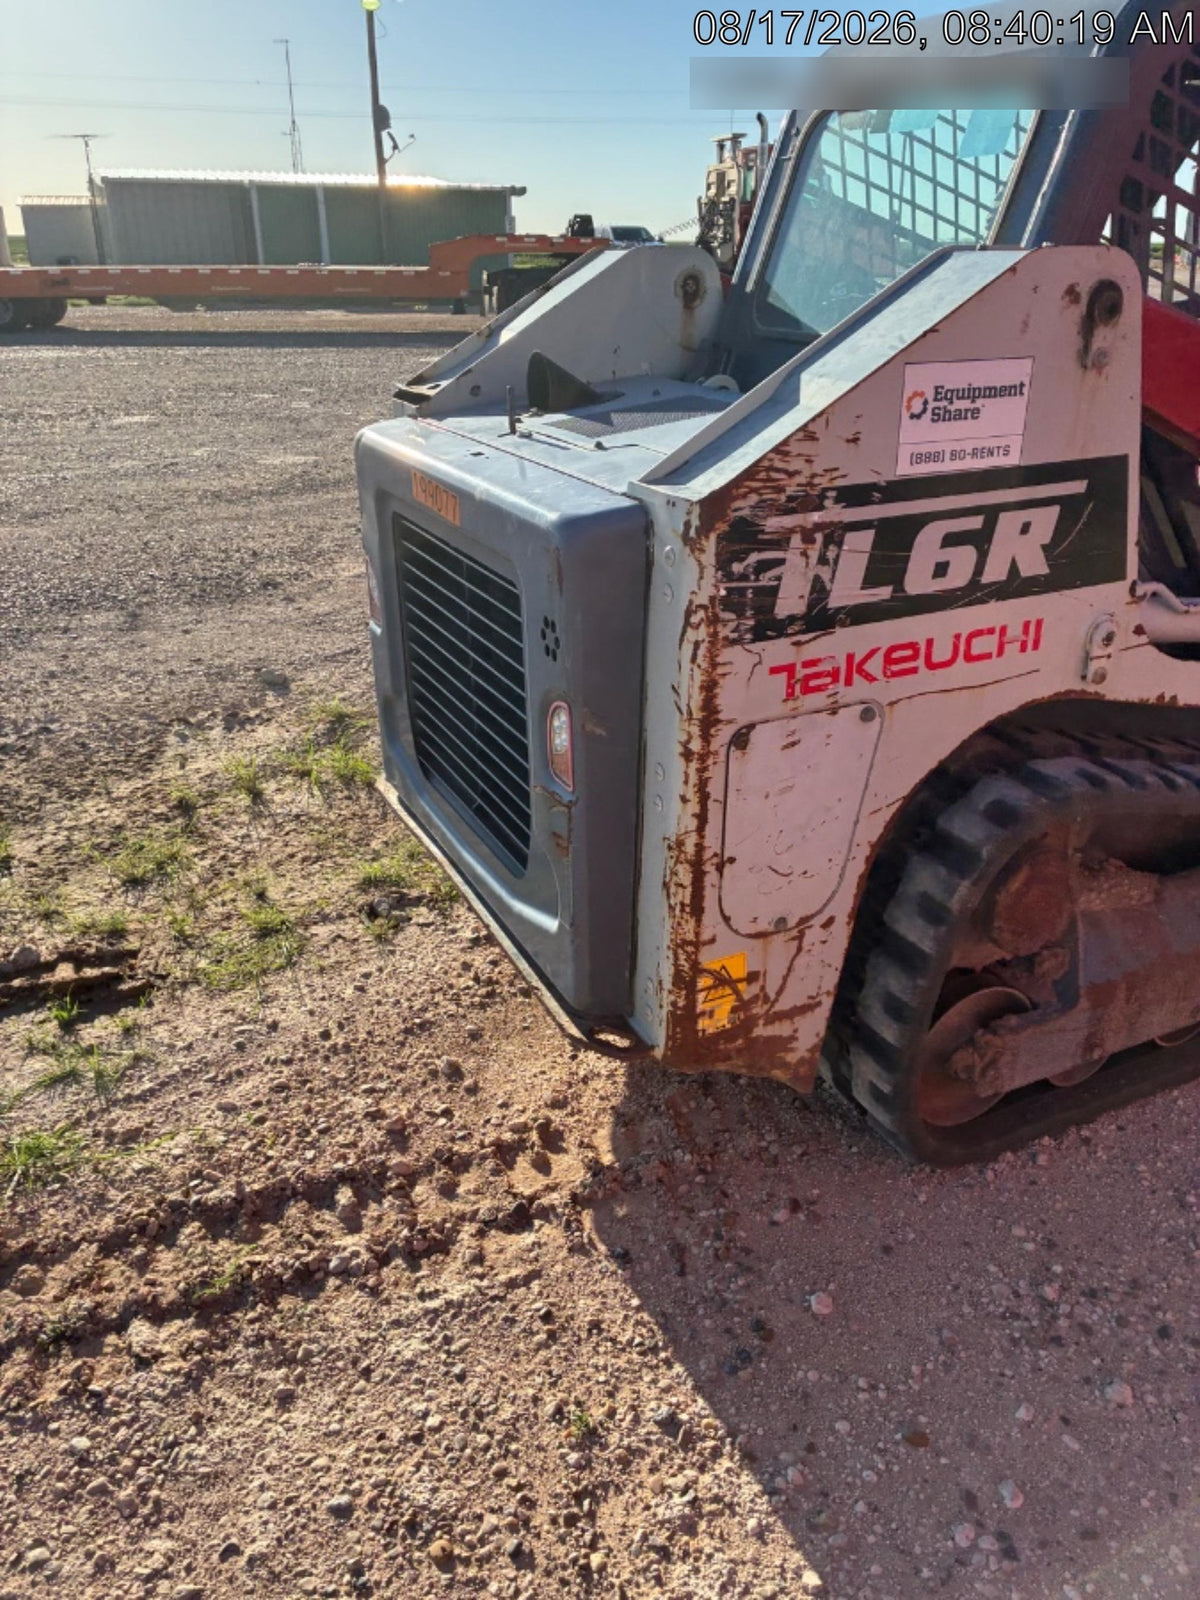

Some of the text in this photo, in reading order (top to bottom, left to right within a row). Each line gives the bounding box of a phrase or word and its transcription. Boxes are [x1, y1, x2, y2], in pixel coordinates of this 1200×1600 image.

[933, 381, 1026, 405] Equipment
[930, 405, 982, 423] Share
[949, 445, 1011, 462] 80-RENTS
